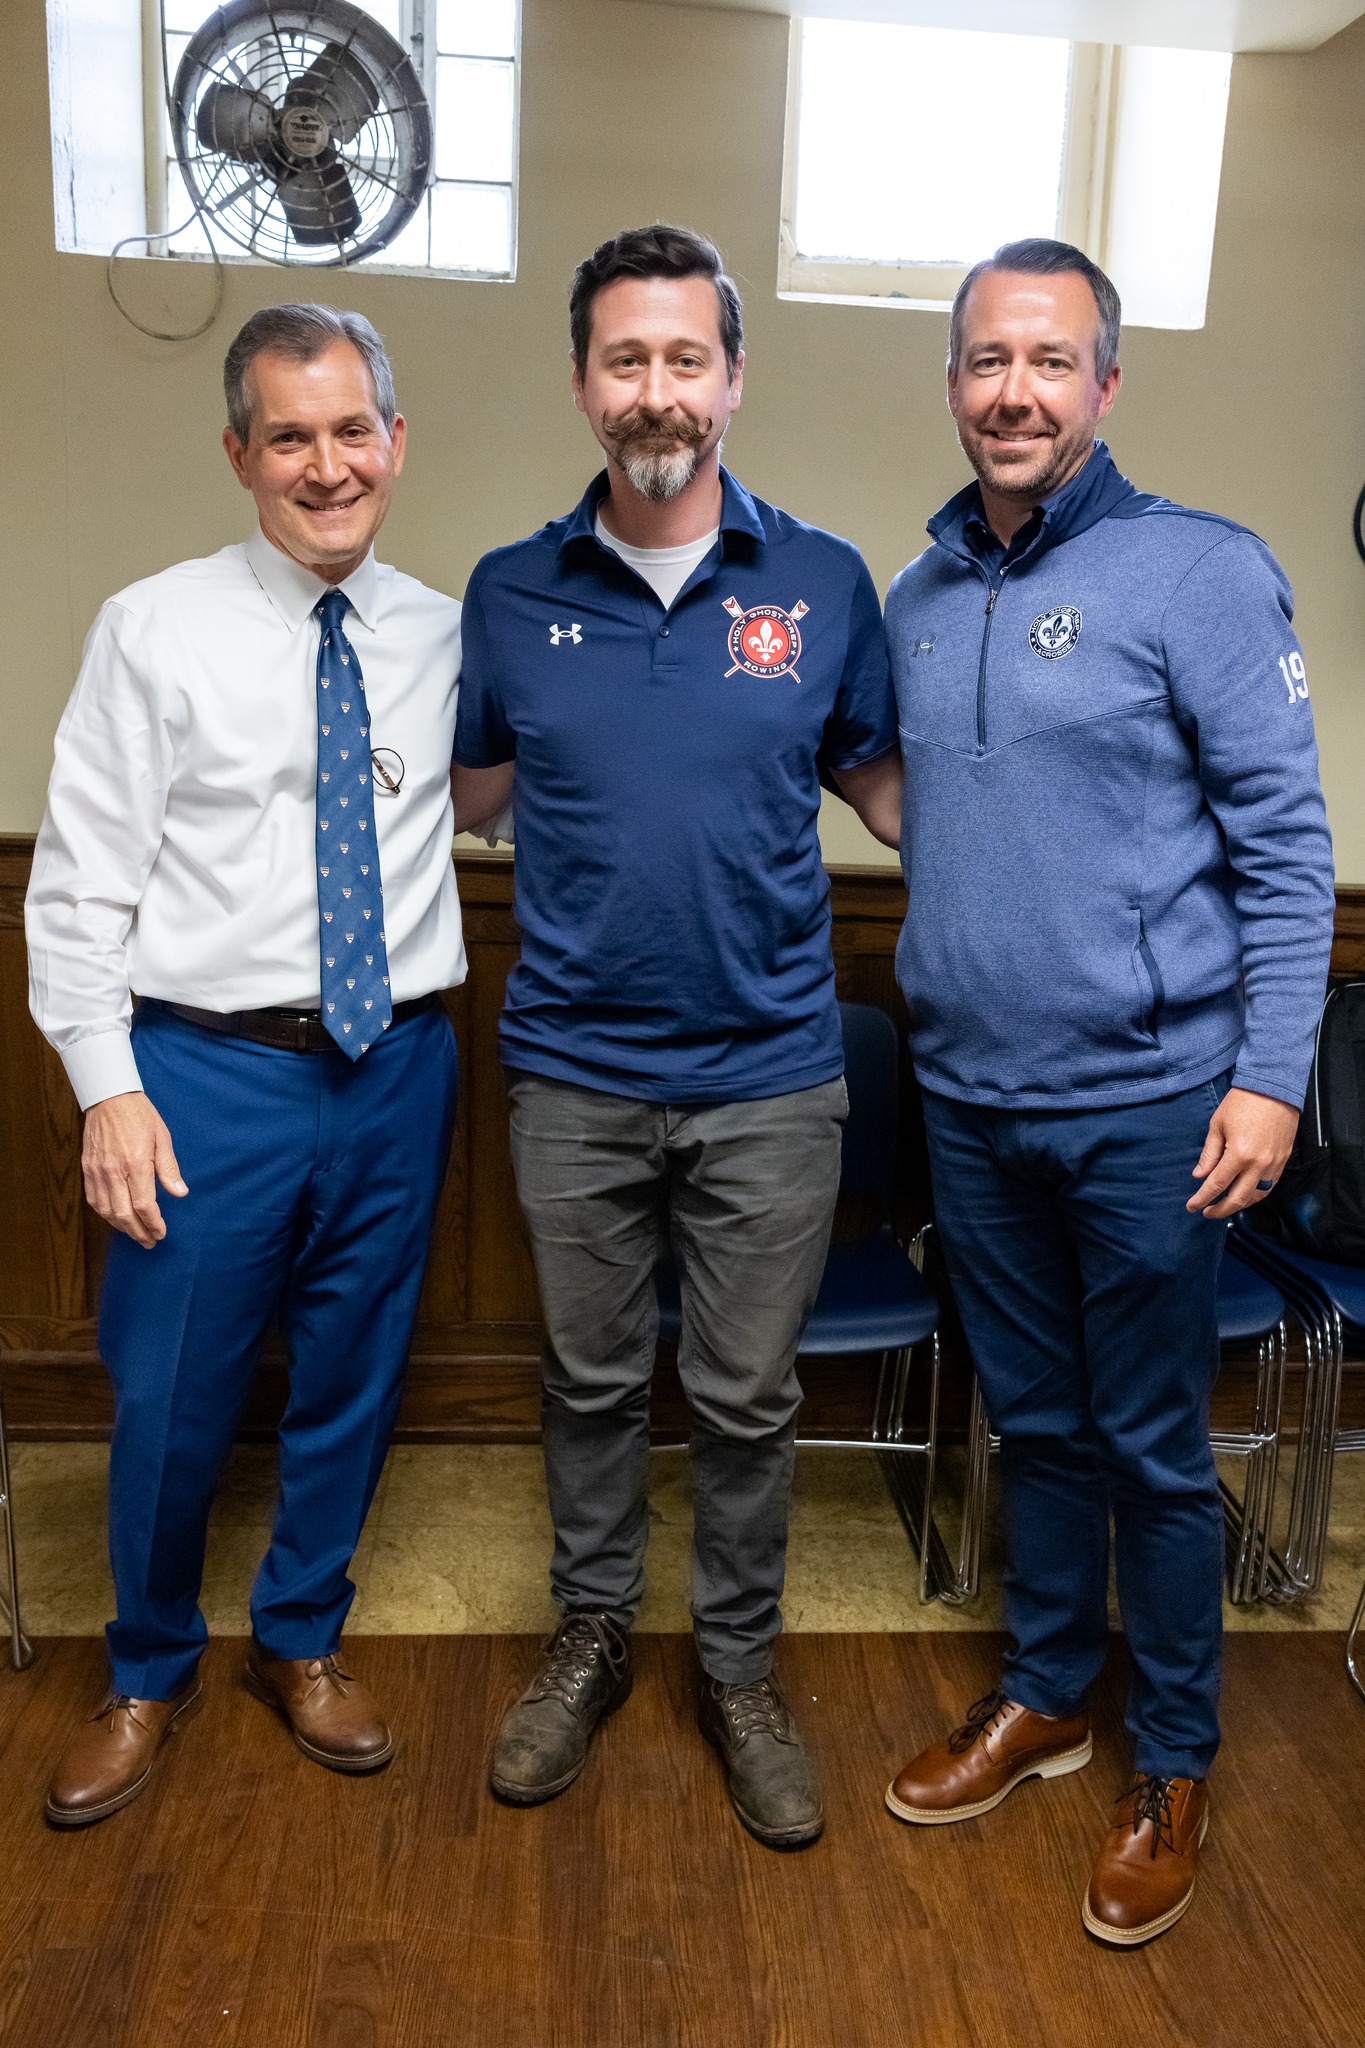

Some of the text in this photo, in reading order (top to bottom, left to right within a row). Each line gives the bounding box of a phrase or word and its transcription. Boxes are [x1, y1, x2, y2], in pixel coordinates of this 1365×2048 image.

[733, 609, 798, 649] HOLY GHOST PREP
[1031, 614, 1046, 633] HOLY
[1049, 607, 1077, 616] GHOST
[1033, 643, 1073, 659] LACROSSE
[743, 660, 787, 674] ROWING
[1278, 651, 1309, 704] 19
